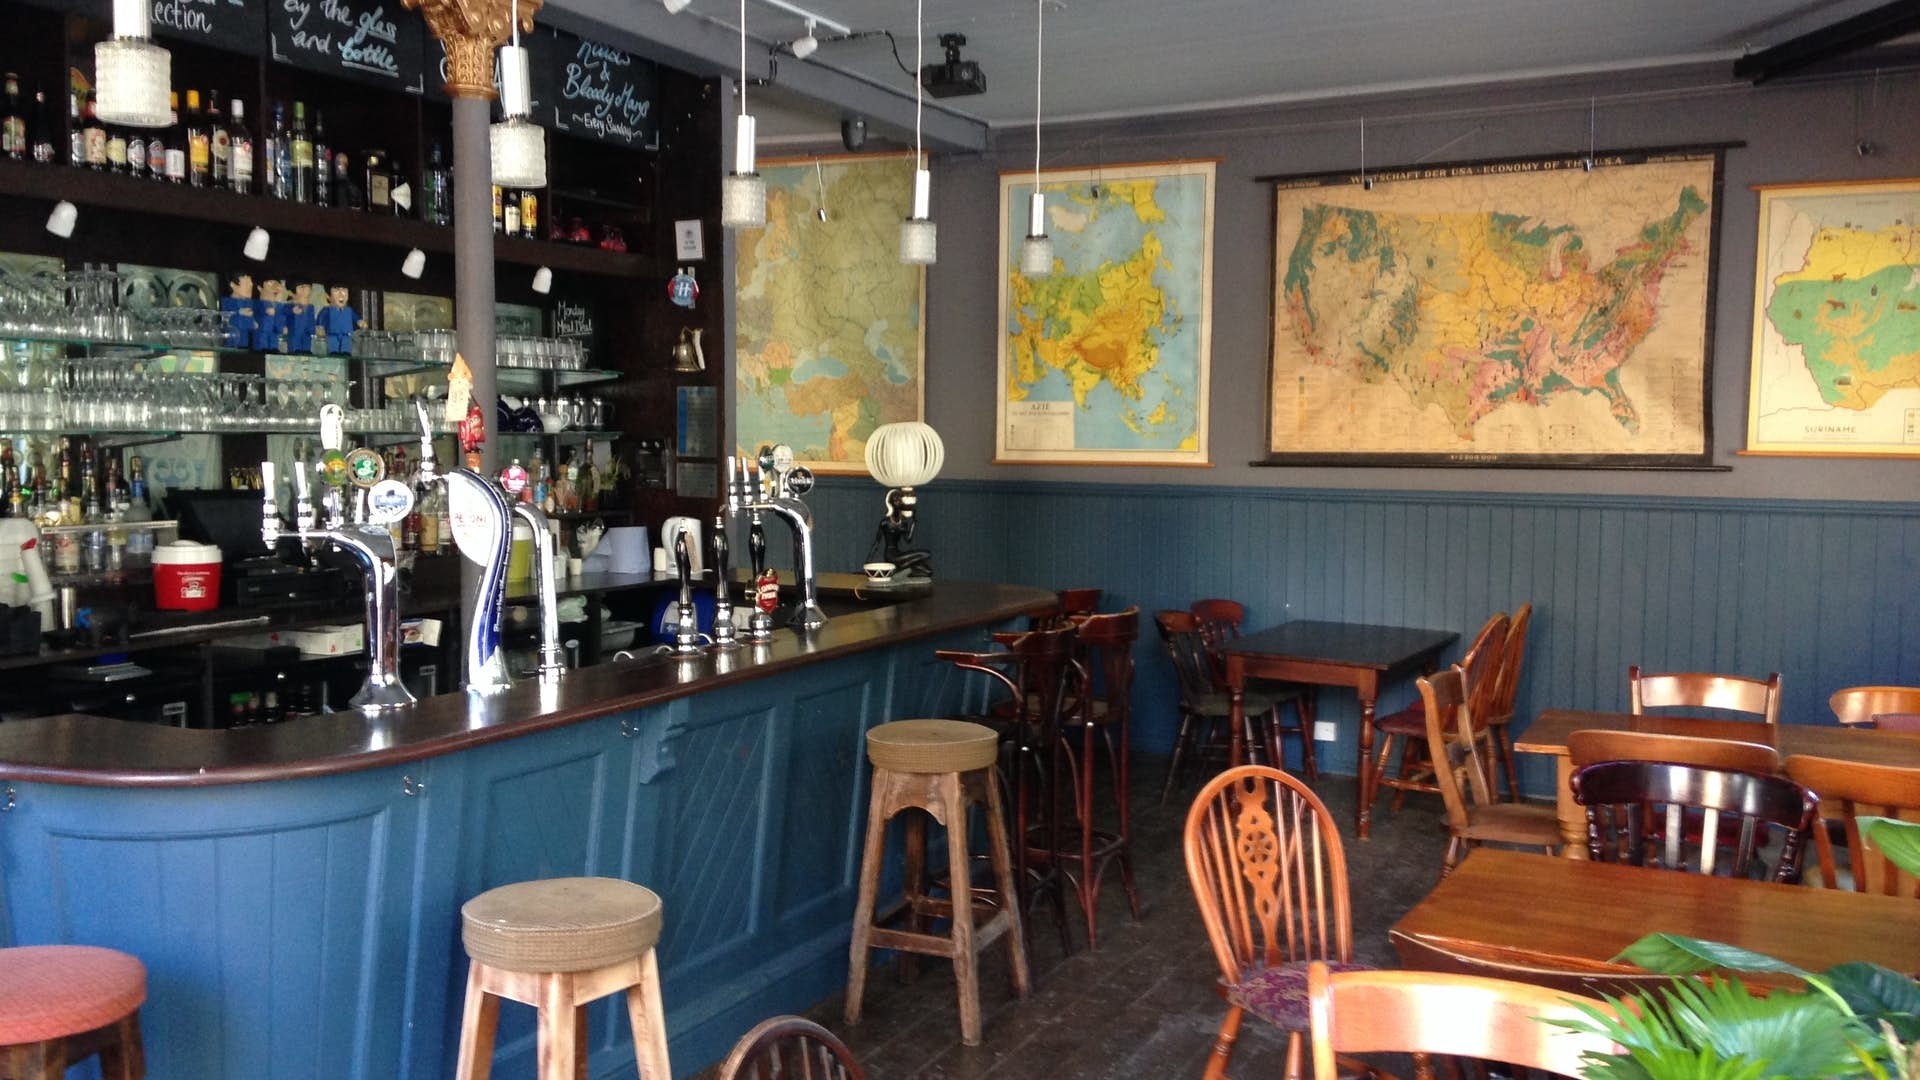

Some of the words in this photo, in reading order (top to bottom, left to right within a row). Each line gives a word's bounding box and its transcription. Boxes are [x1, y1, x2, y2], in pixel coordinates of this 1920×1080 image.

[151, 0, 212, 33] ection
[354, 5, 397, 44] glass
[291, 30, 331, 55] and
[337, 37, 398, 71] bottle
[600, 61, 610, 82] &
[562, 63, 615, 117] Bloody
[1424, 169, 1447, 178] DER
[1451, 167, 1473, 176] USA
[1483, 162, 1539, 173] ECONOMY
[1543, 161, 1560, 169] OF
[558, 300, 586, 323] Monday
